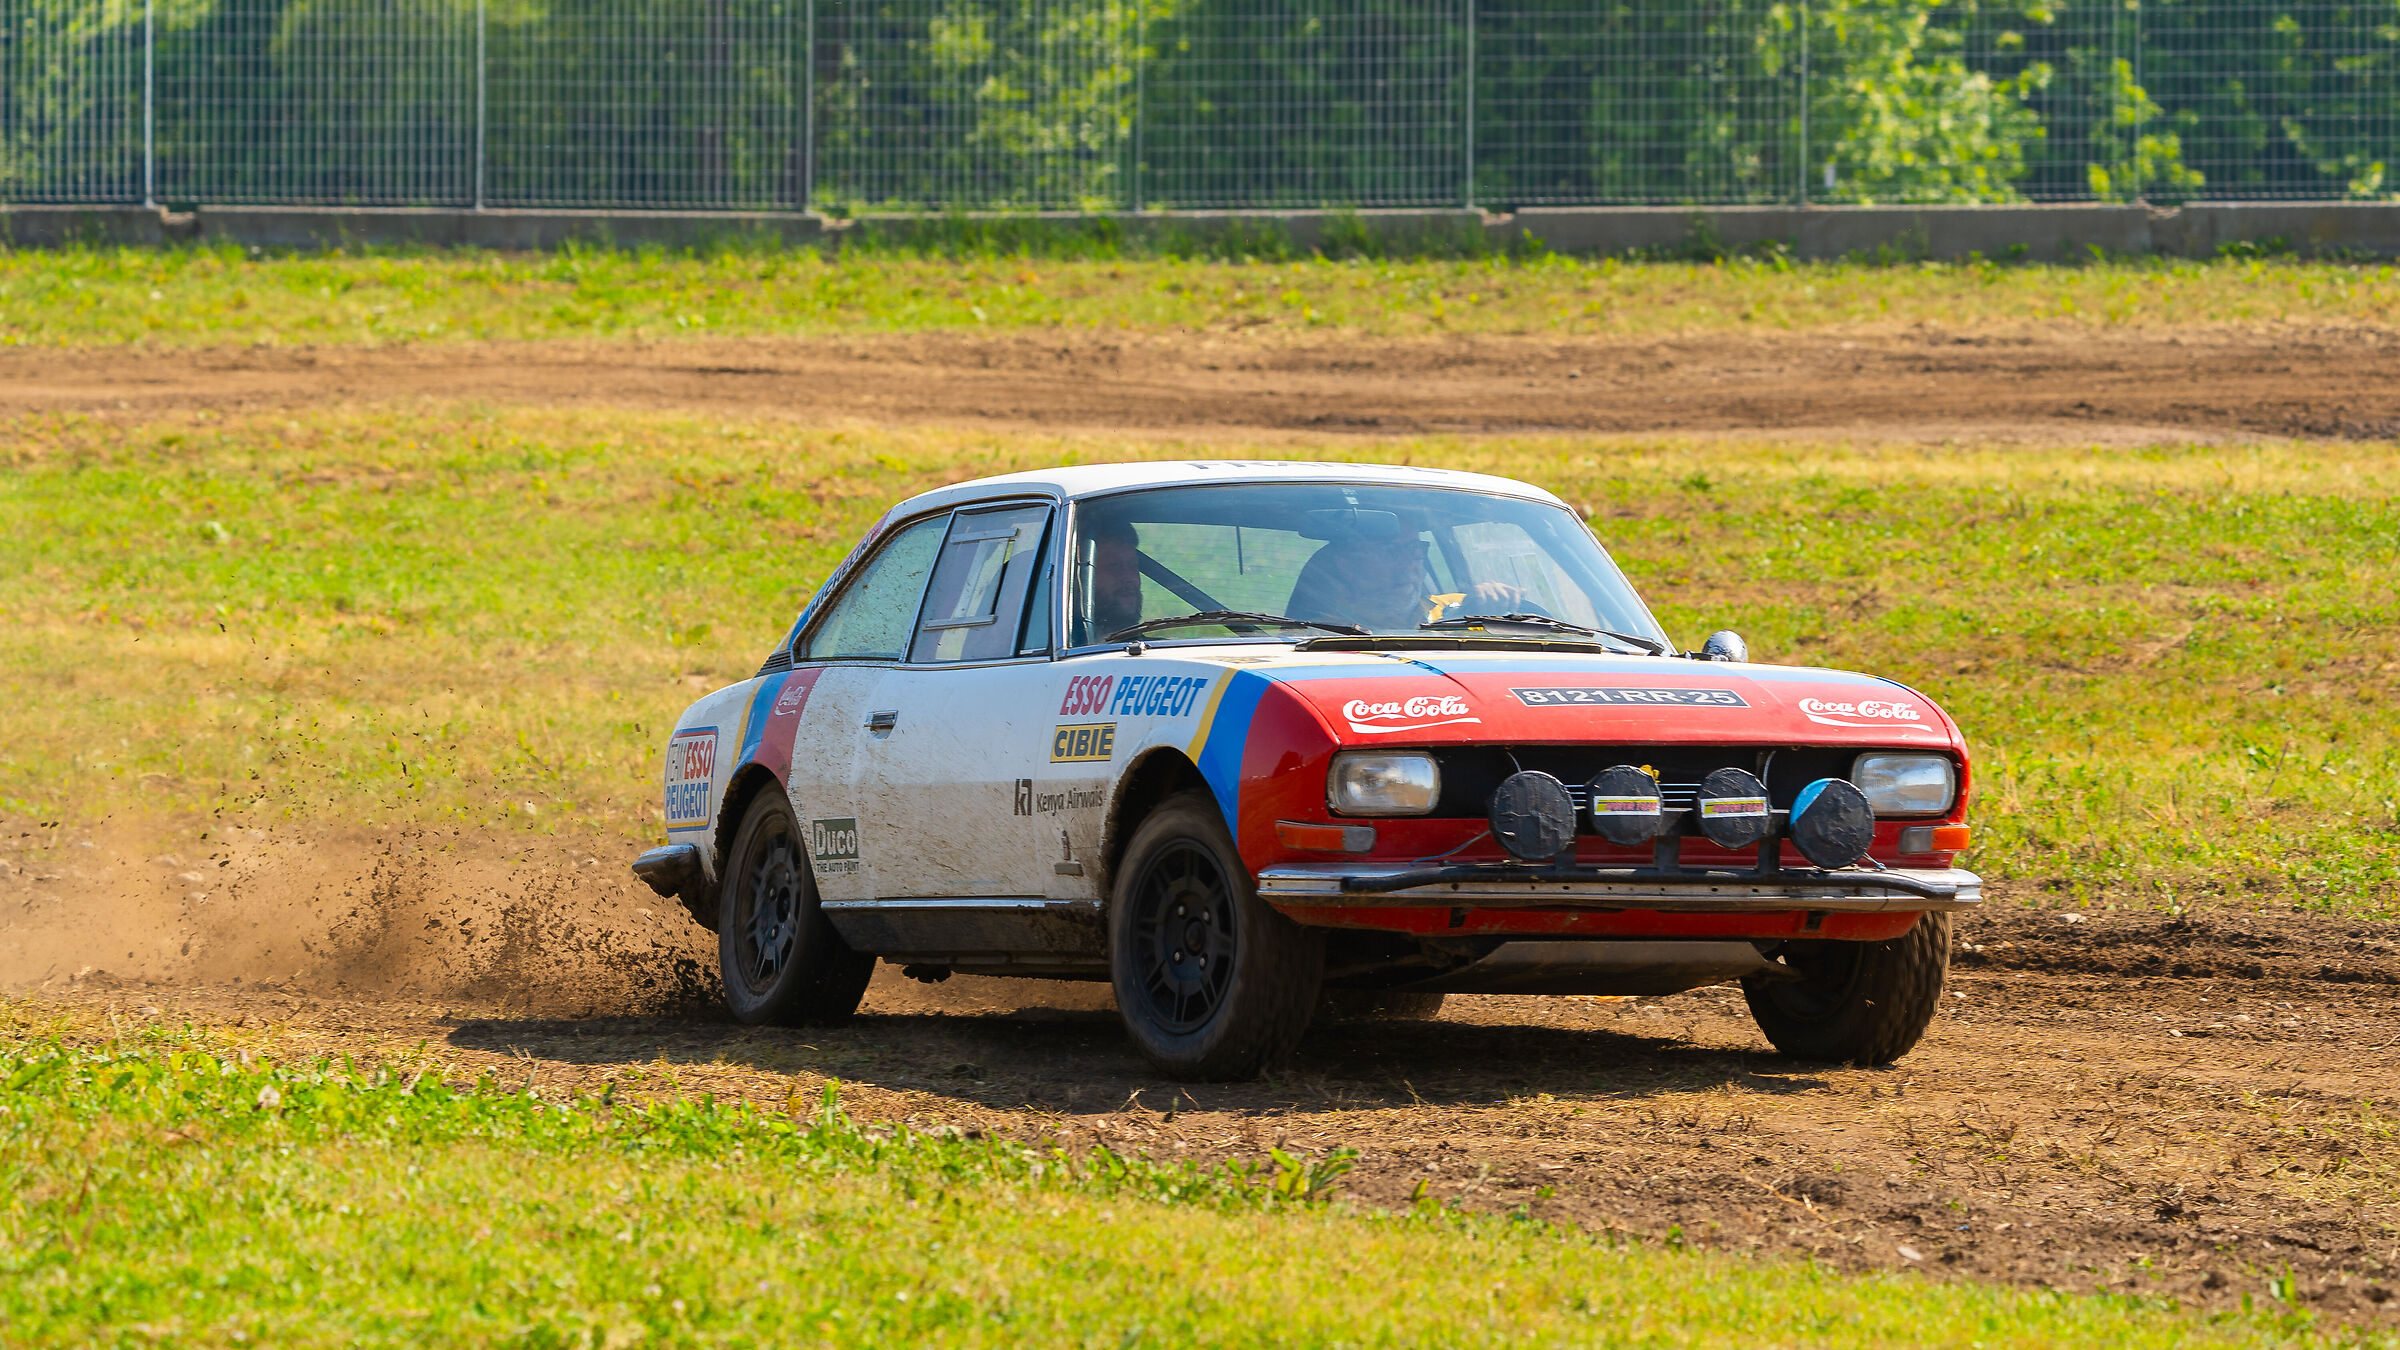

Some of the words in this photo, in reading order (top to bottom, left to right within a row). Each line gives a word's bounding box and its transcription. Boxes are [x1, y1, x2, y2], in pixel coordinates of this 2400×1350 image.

[1059, 675, 1114, 716] ESSO
[1109, 676, 1208, 717] PEUGEOT
[1343, 699, 1407, 723] Coca
[1403, 696, 1470, 718] Cola
[1798, 698, 1862, 717] Coca
[1857, 700, 1921, 721] Cola
[684, 740, 713, 780] ESSO
[666, 782, 709, 820] PEUGEOT
[1036, 792, 1064, 817] Kenya
[815, 822, 856, 856] Duco
